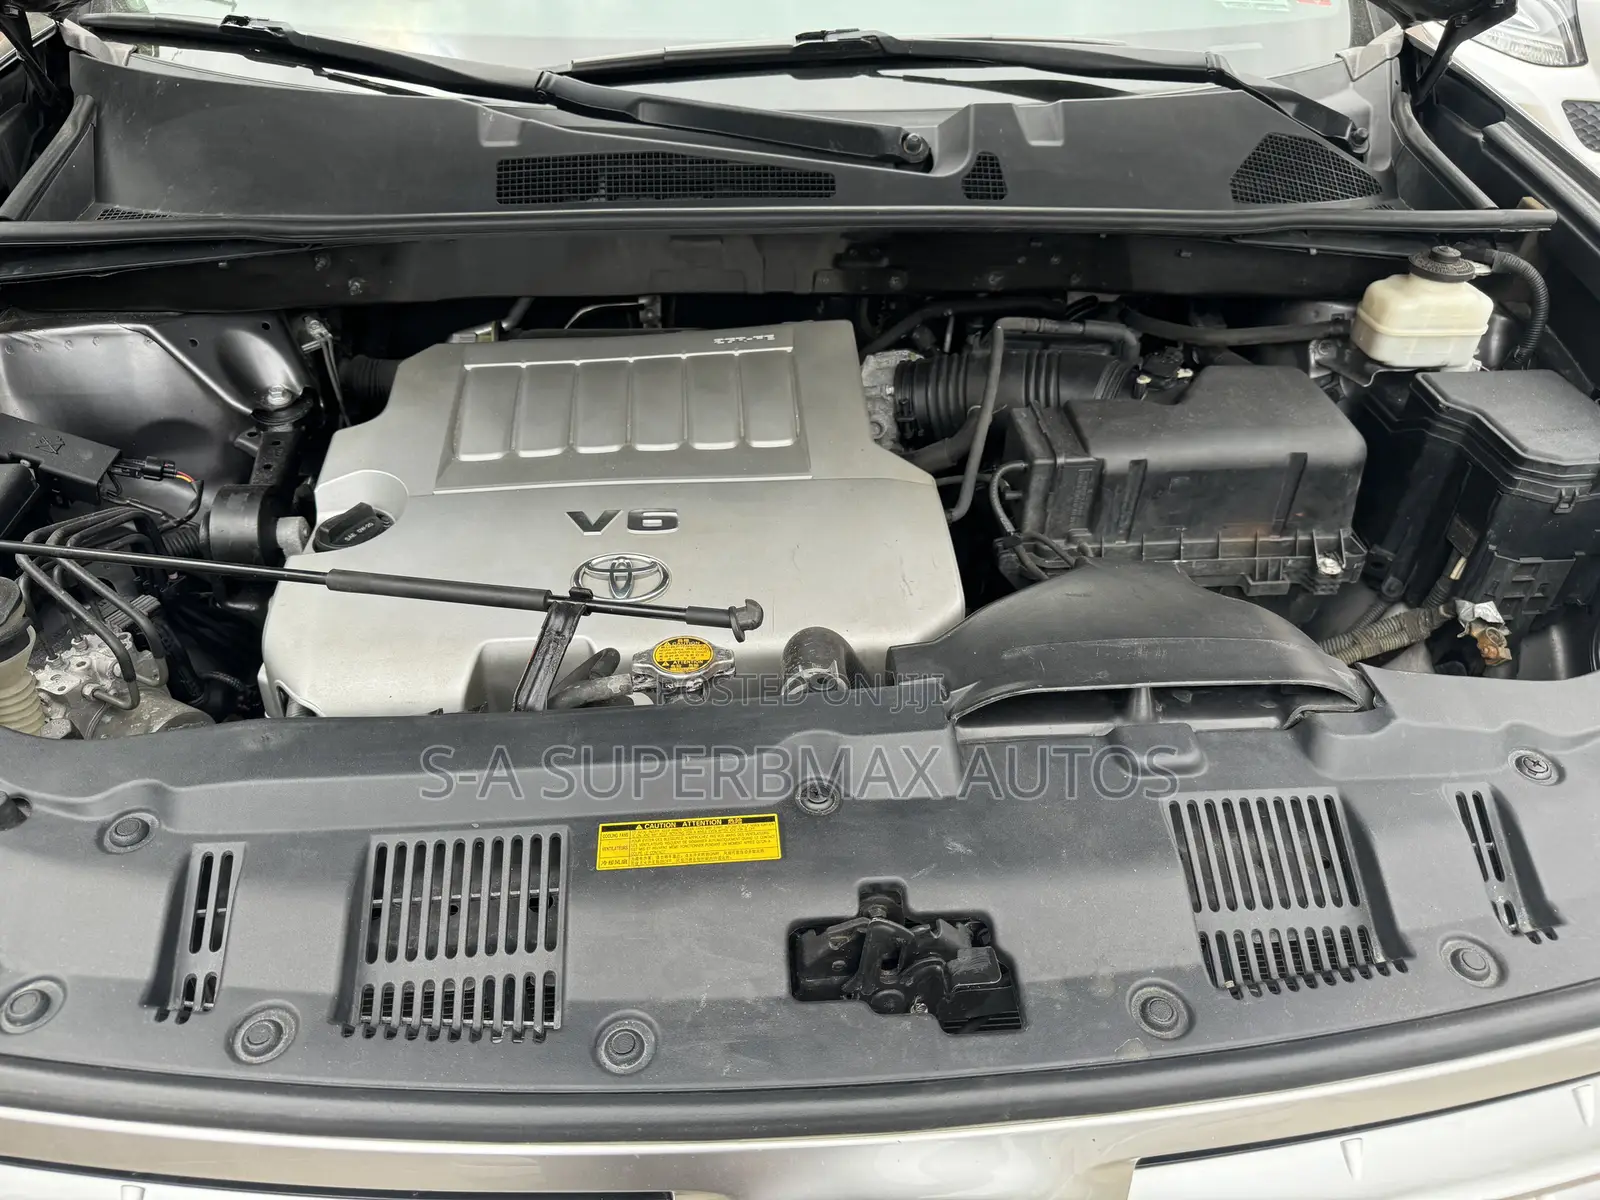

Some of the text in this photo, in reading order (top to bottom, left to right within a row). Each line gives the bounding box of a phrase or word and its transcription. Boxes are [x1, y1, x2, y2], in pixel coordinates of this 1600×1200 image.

[564, 507, 680, 536] V6
[644, 819, 723, 830] CAUTION ATTENTION
